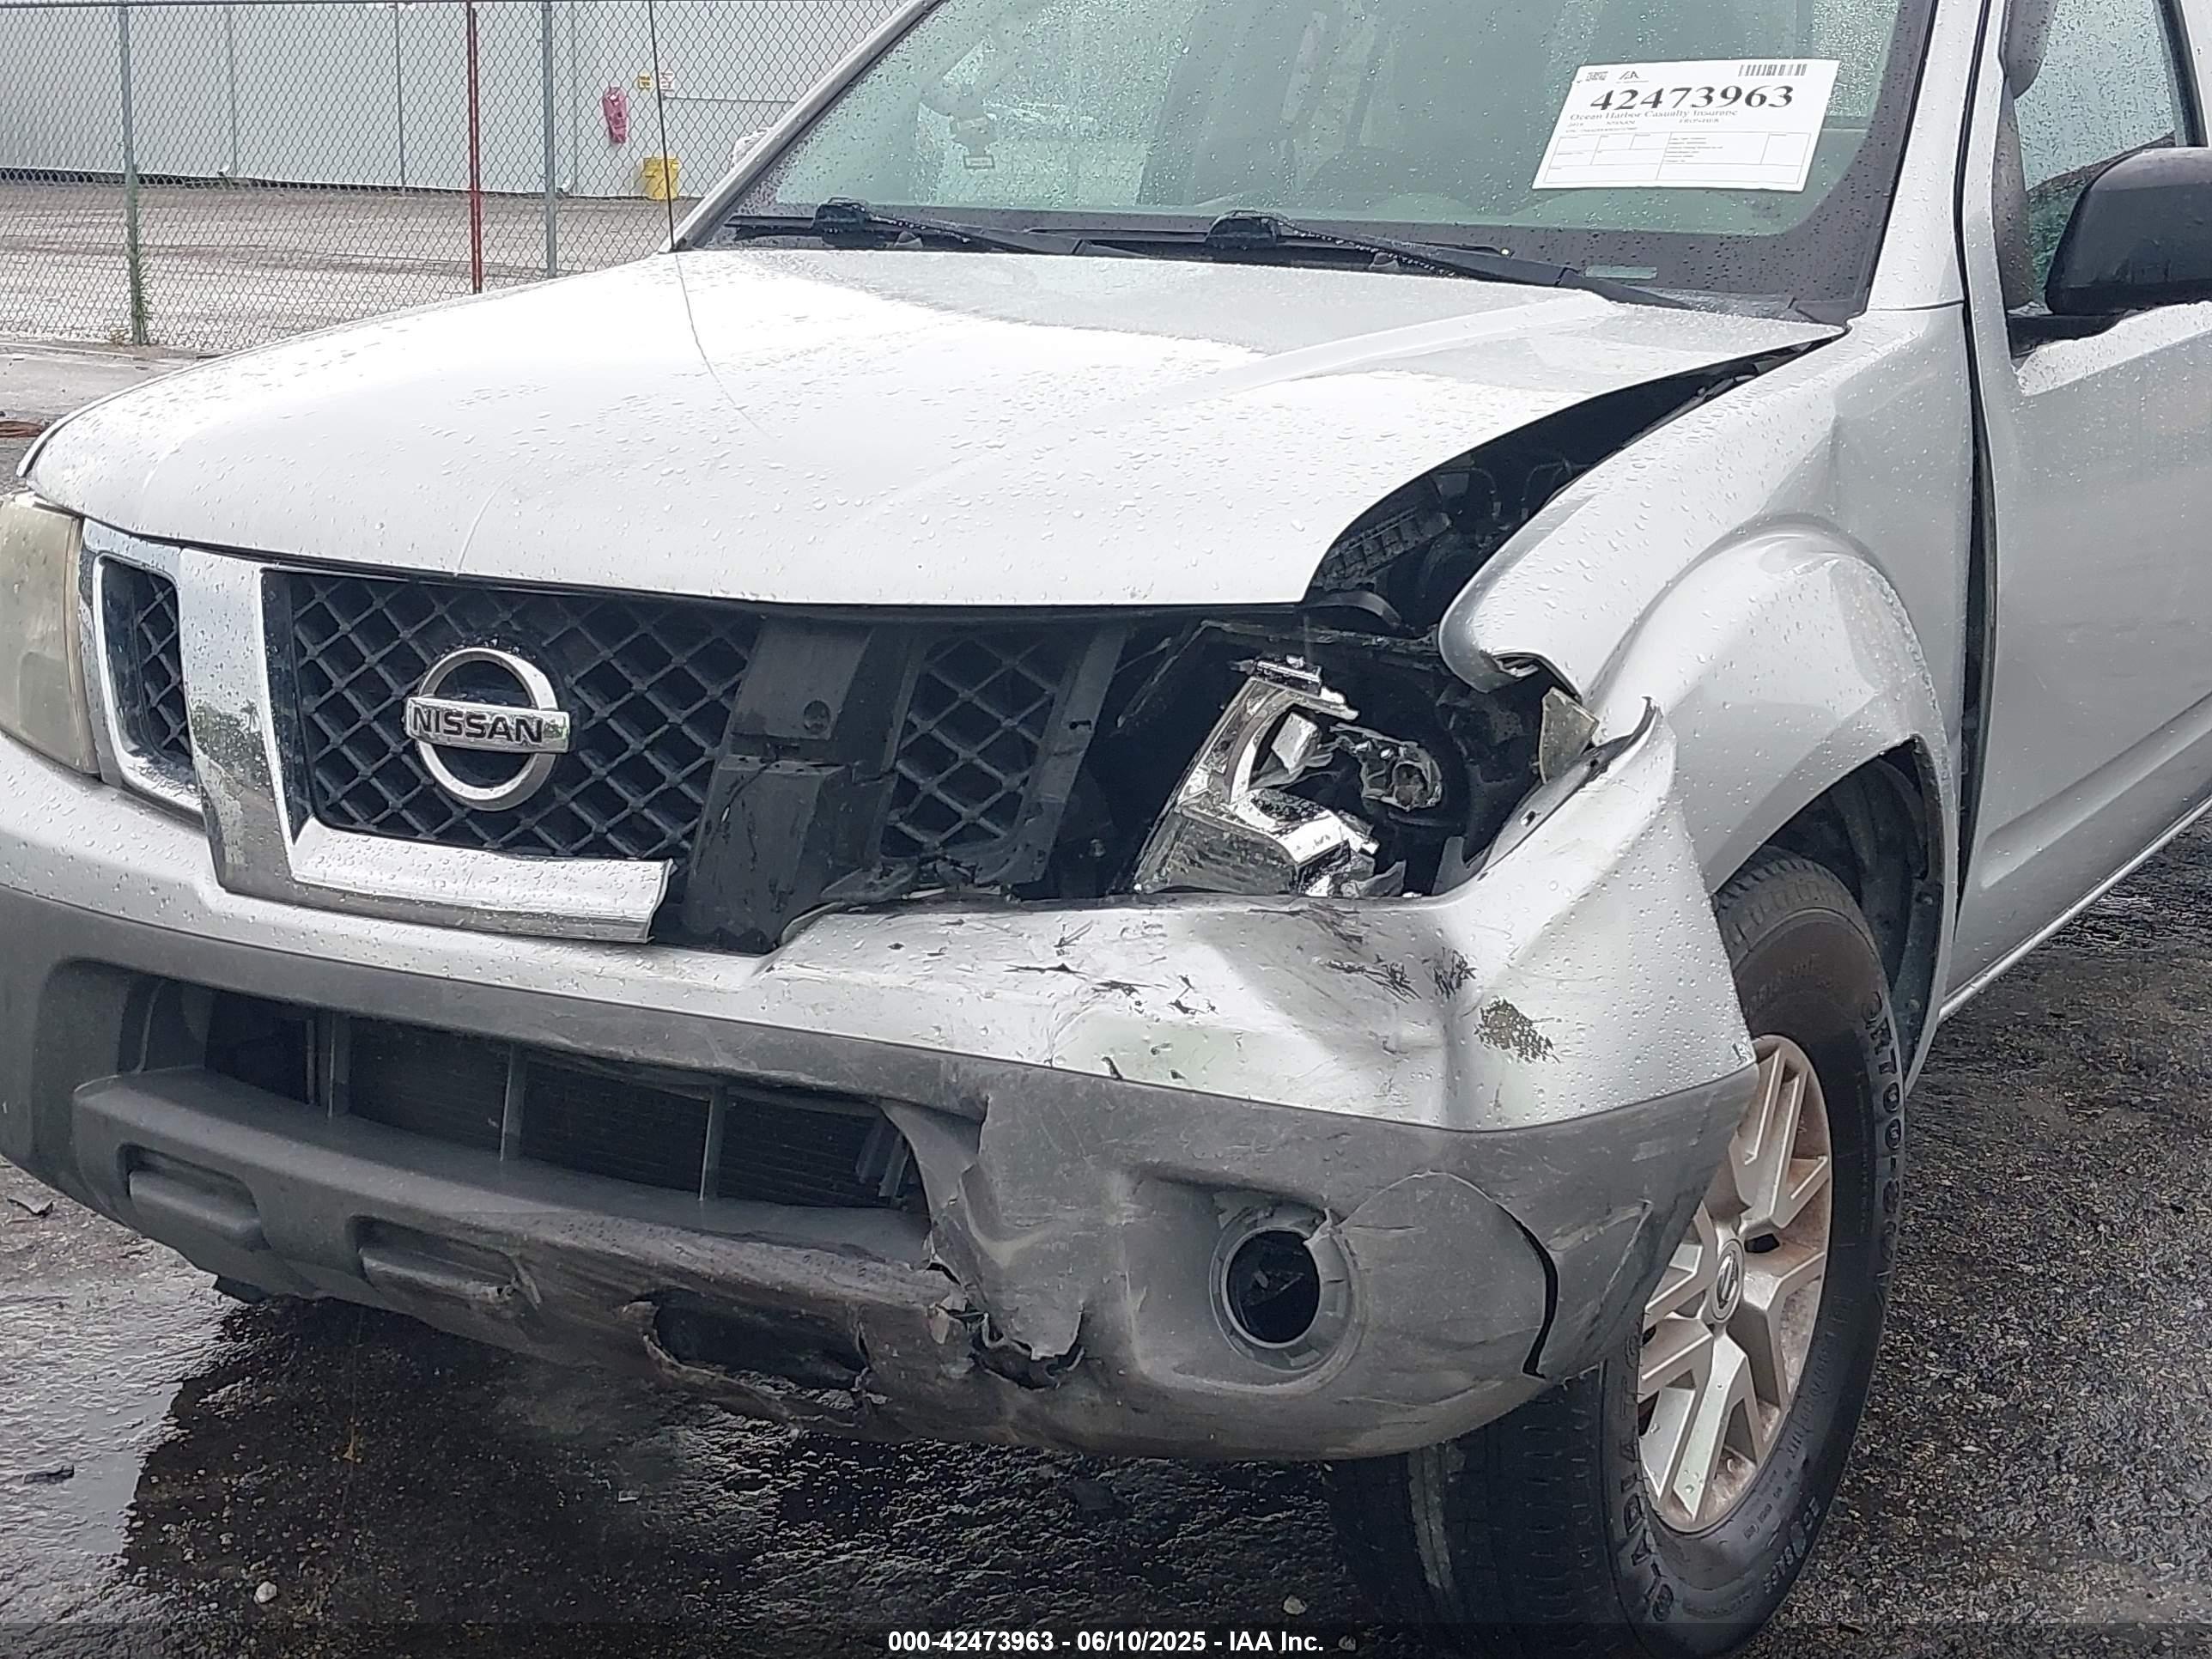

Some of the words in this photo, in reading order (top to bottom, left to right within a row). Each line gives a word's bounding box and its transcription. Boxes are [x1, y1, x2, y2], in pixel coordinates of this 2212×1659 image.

[1590, 85, 1794, 111] 42473963
[1570, 112, 1602, 121] Ocean
[1644, 110, 1690, 118] Casualty
[412, 705, 544, 743] NISSAN
[1619, 1333, 1674, 1622] GLADIATO
